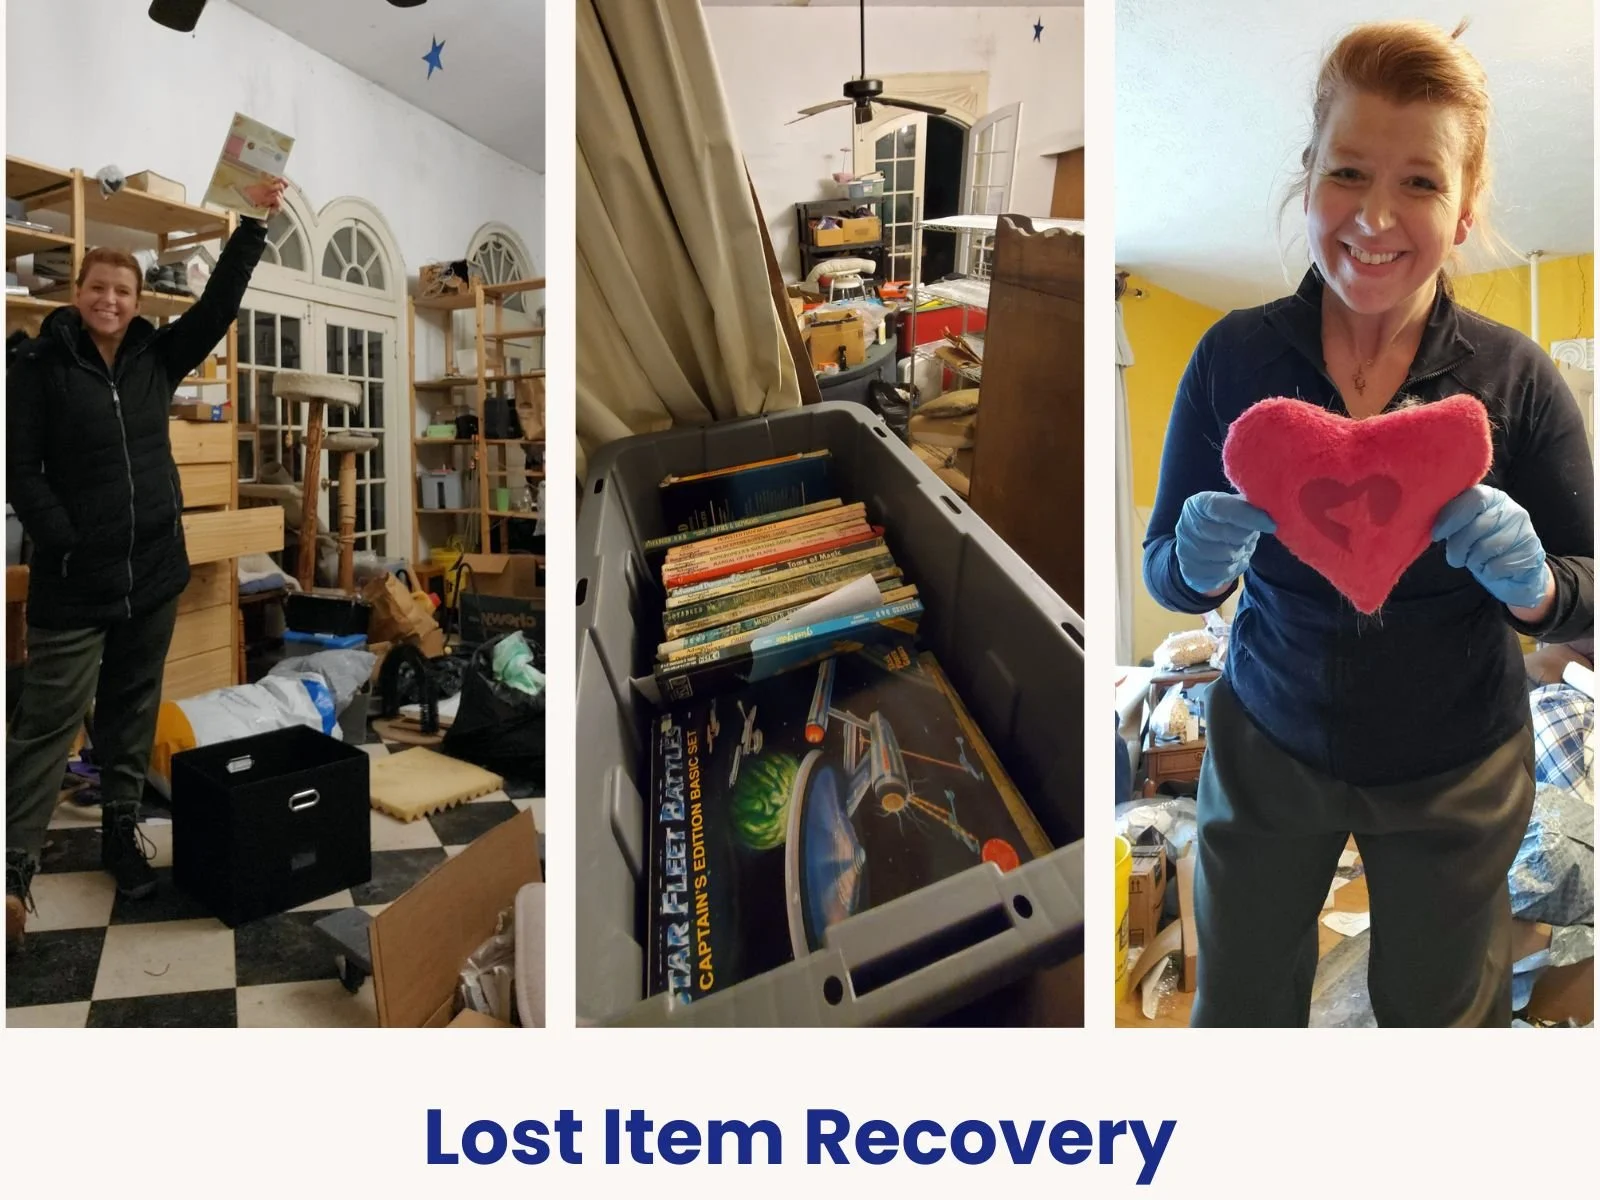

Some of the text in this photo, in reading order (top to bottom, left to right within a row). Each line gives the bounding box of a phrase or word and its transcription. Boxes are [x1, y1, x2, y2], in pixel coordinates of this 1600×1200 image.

[787, 560, 808, 570] Tome
[819, 550, 842, 561] Magic
[660, 726, 686, 823] BATTLES
[662, 827, 689, 914] FLEET
[686, 730, 714, 990] CAPTAIN'S EDITION BASIC SET
